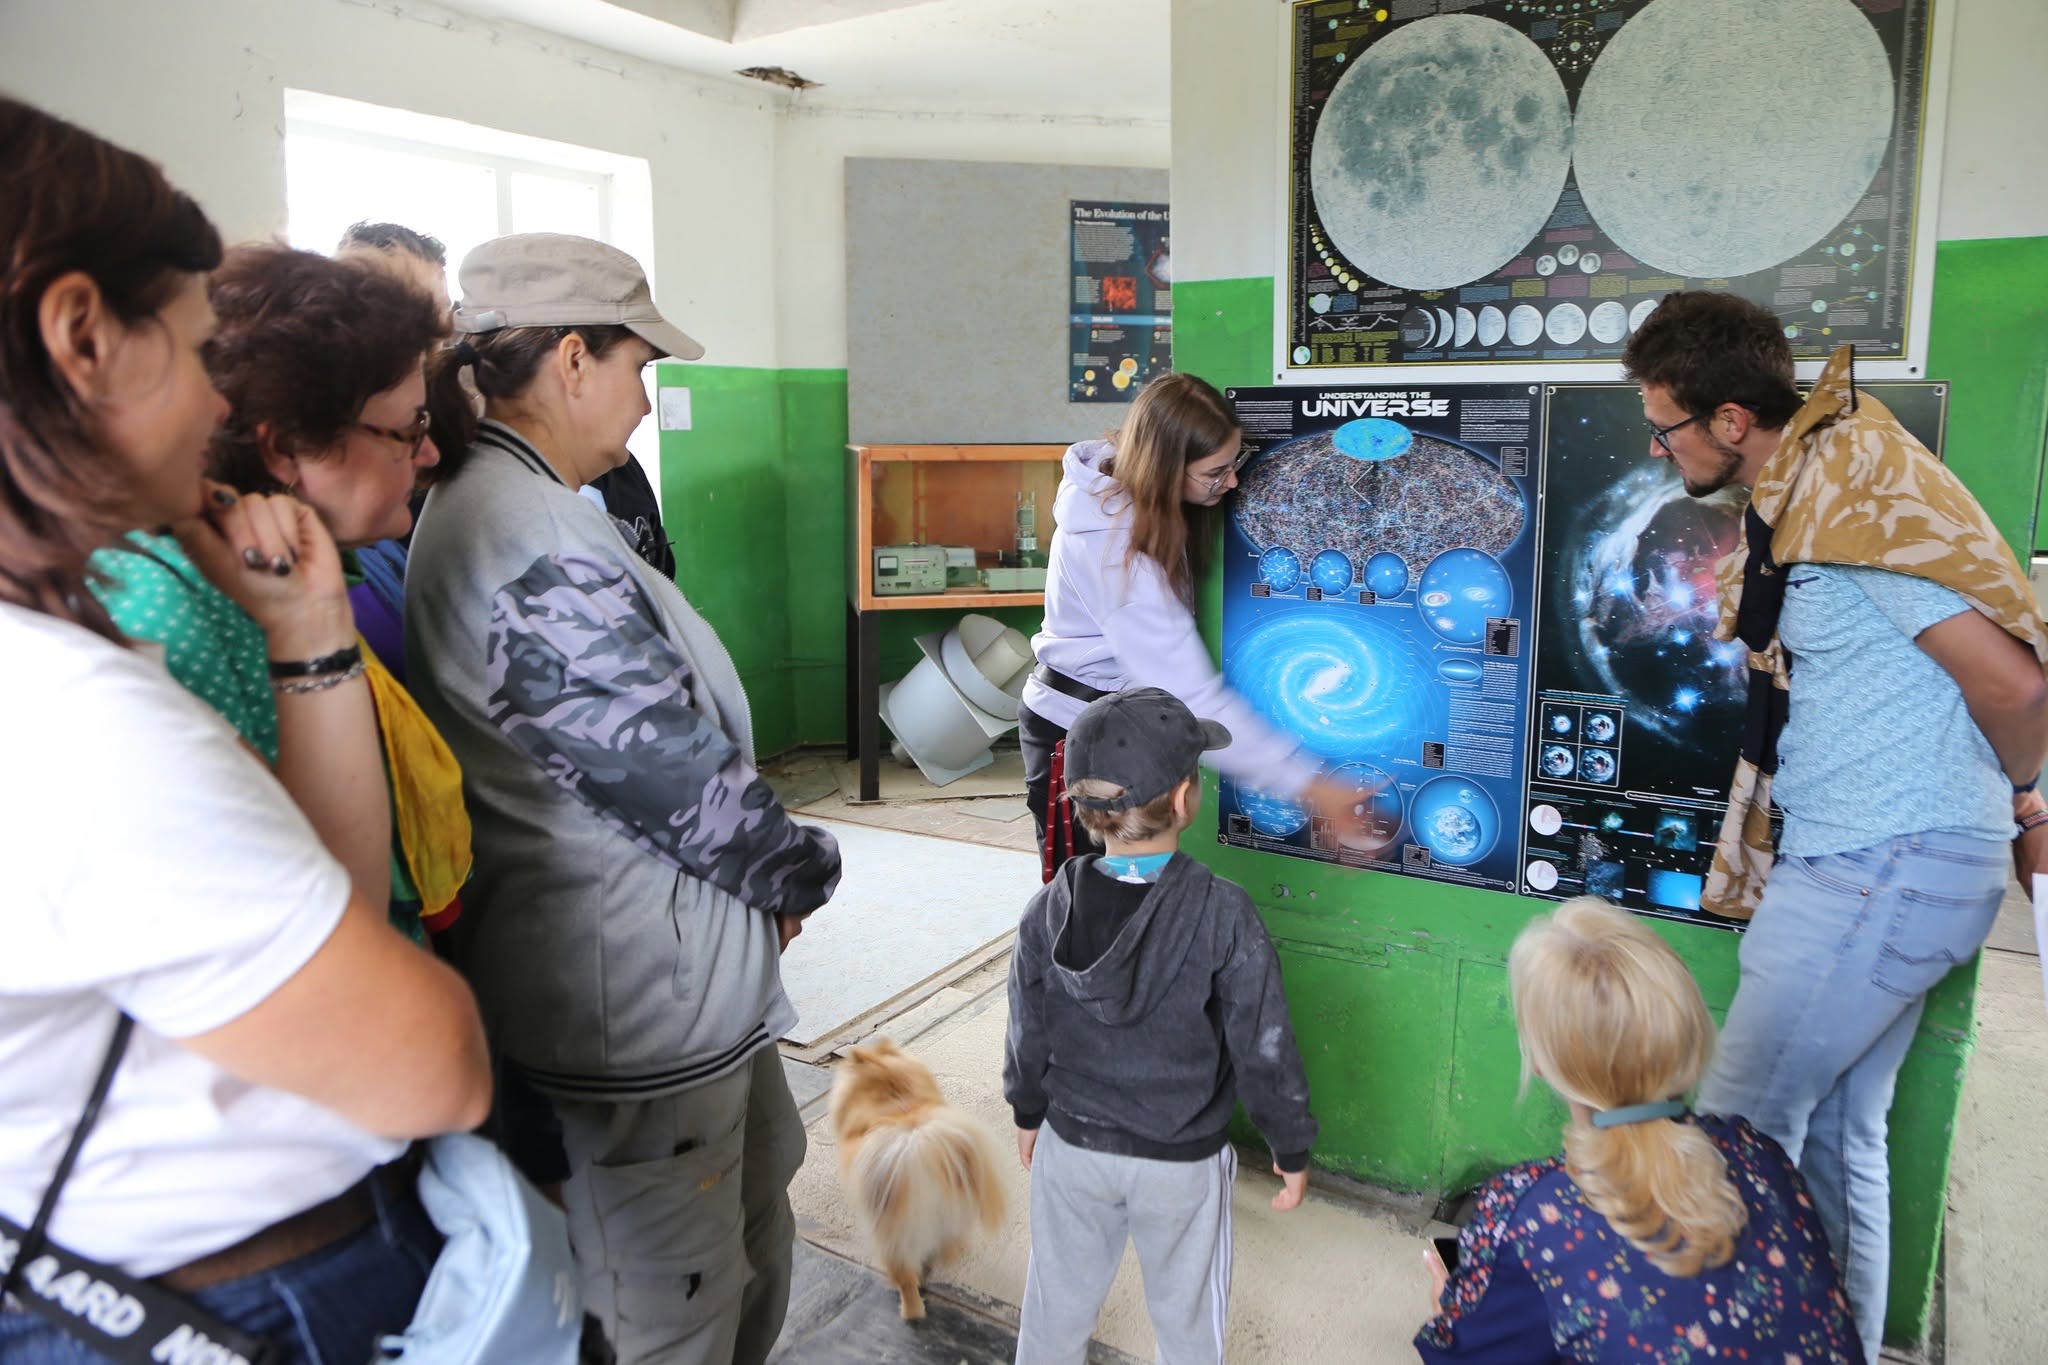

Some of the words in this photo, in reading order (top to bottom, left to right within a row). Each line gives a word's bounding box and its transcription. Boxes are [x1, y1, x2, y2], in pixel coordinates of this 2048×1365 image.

[1074, 208, 1092, 218] The
[1093, 208, 1136, 219] Evolution
[1137, 210, 1148, 220] of
[1147, 210, 1162, 220] the
[1319, 392, 1407, 400] UNDERSTANDING
[1409, 391, 1431, 399] THE
[1302, 400, 1450, 417] UNIVERSE
